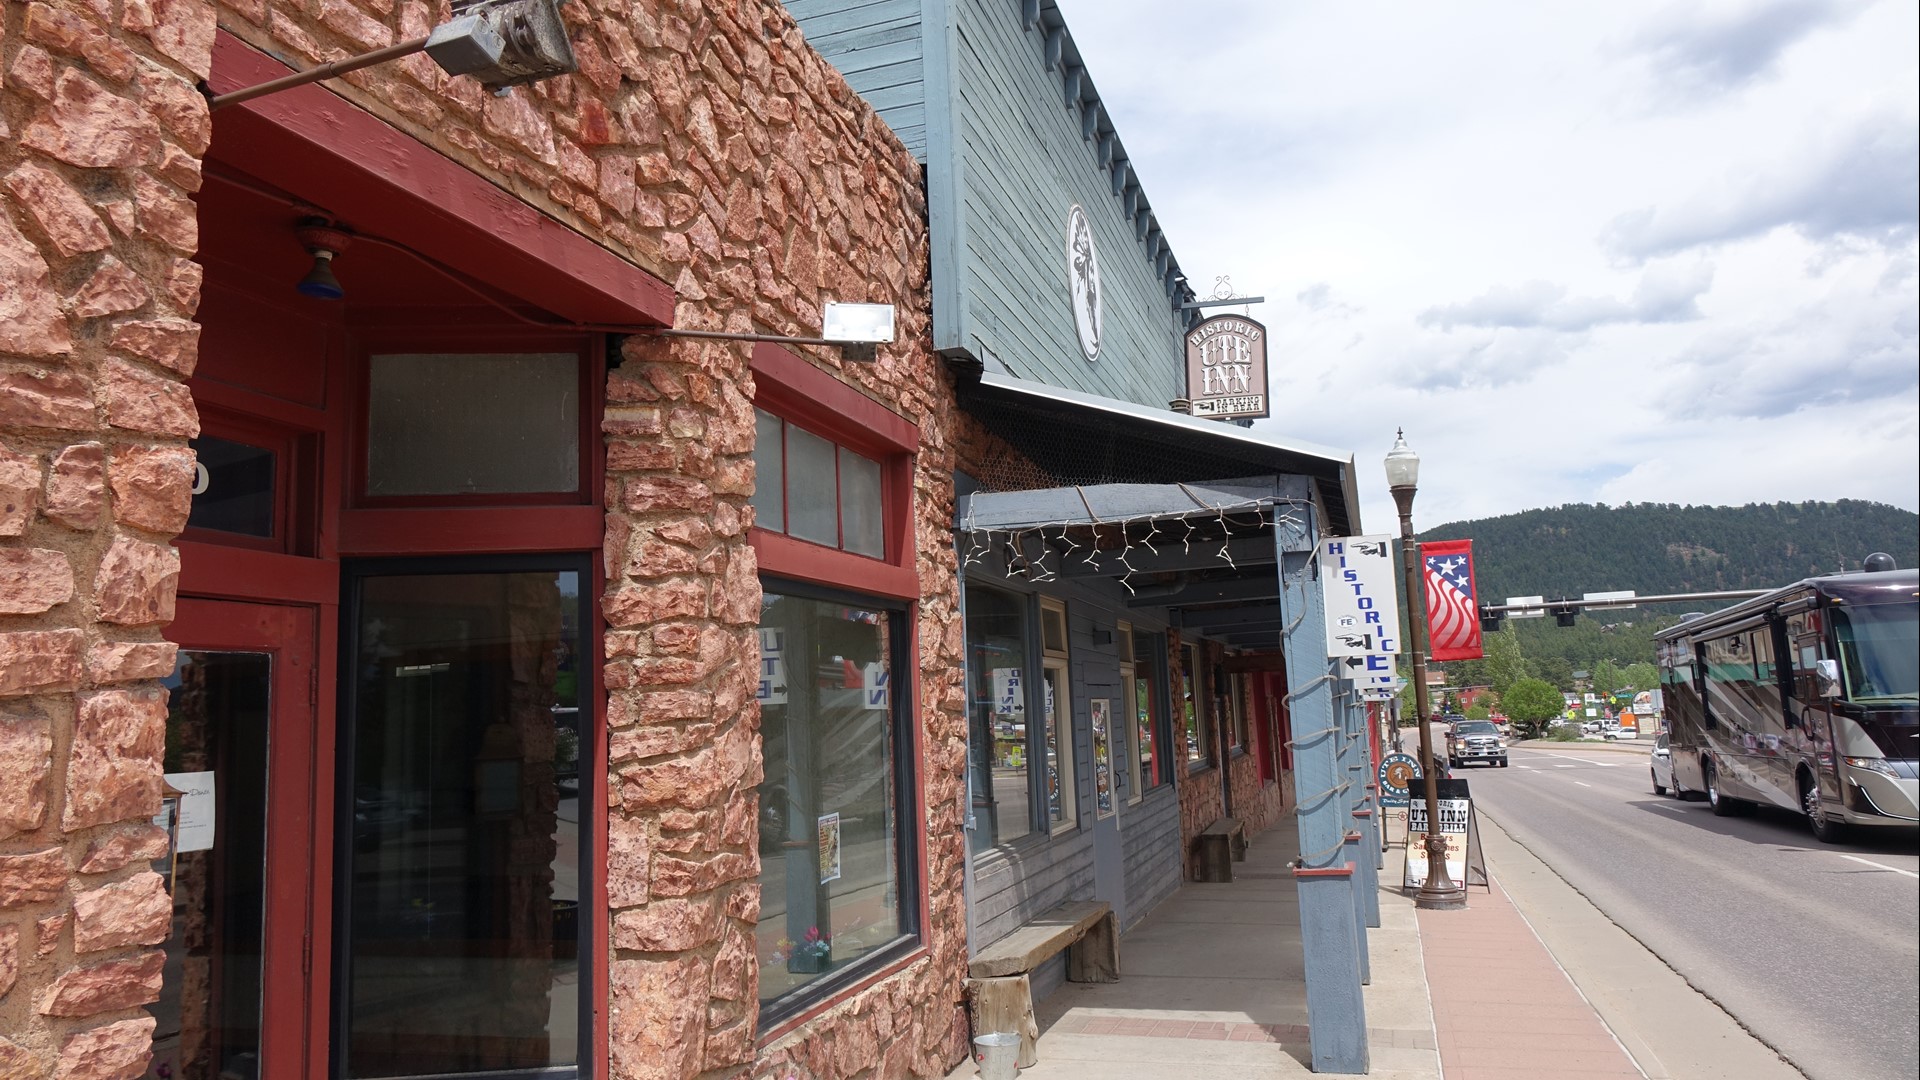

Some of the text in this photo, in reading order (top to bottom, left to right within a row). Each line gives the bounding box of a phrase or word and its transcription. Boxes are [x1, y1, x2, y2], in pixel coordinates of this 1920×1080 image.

[1190, 321, 1260, 347] HISTORIC
[1200, 334, 1252, 366] UTE
[1201, 364, 1251, 395] INN
[1217, 397, 1259, 406] PARKING
[1217, 405, 1228, 413] IN
[1328, 543, 1394, 652] HISTORIC
[1380, 756, 1421, 777] UTE INN
[1382, 780, 1394, 792] BAR
[1411, 809, 1467, 822] UT INN
